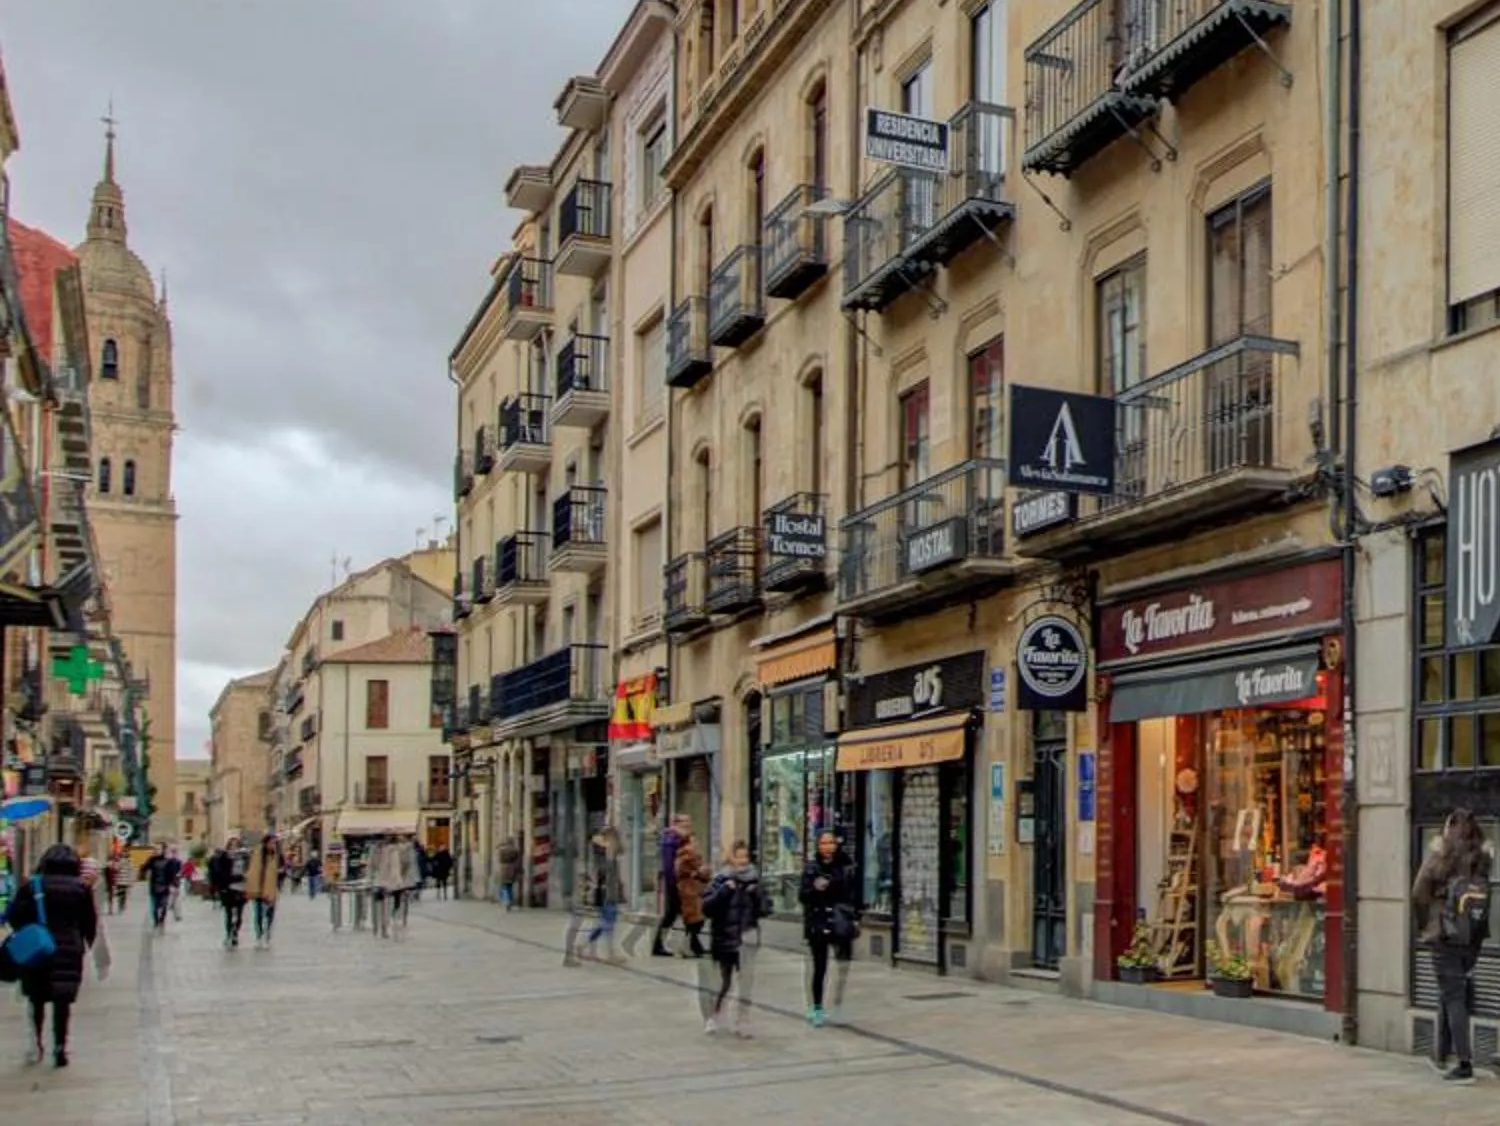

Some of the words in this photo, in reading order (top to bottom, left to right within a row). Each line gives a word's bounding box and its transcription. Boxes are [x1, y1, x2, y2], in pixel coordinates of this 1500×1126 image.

[876, 113, 940, 145] RESIDENCIA
[867, 135, 946, 168] UNIVERSITARIA
[774, 514, 822, 535] Hostal
[1014, 491, 1065, 532] TORMES
[769, 533, 825, 555] Tormes
[908, 525, 951, 573] HOSTAL
[1121, 608, 1146, 654] La
[1144, 593, 1216, 641] Favorita
[1235, 671, 1252, 706] La
[1251, 665, 1304, 697] Favorita
